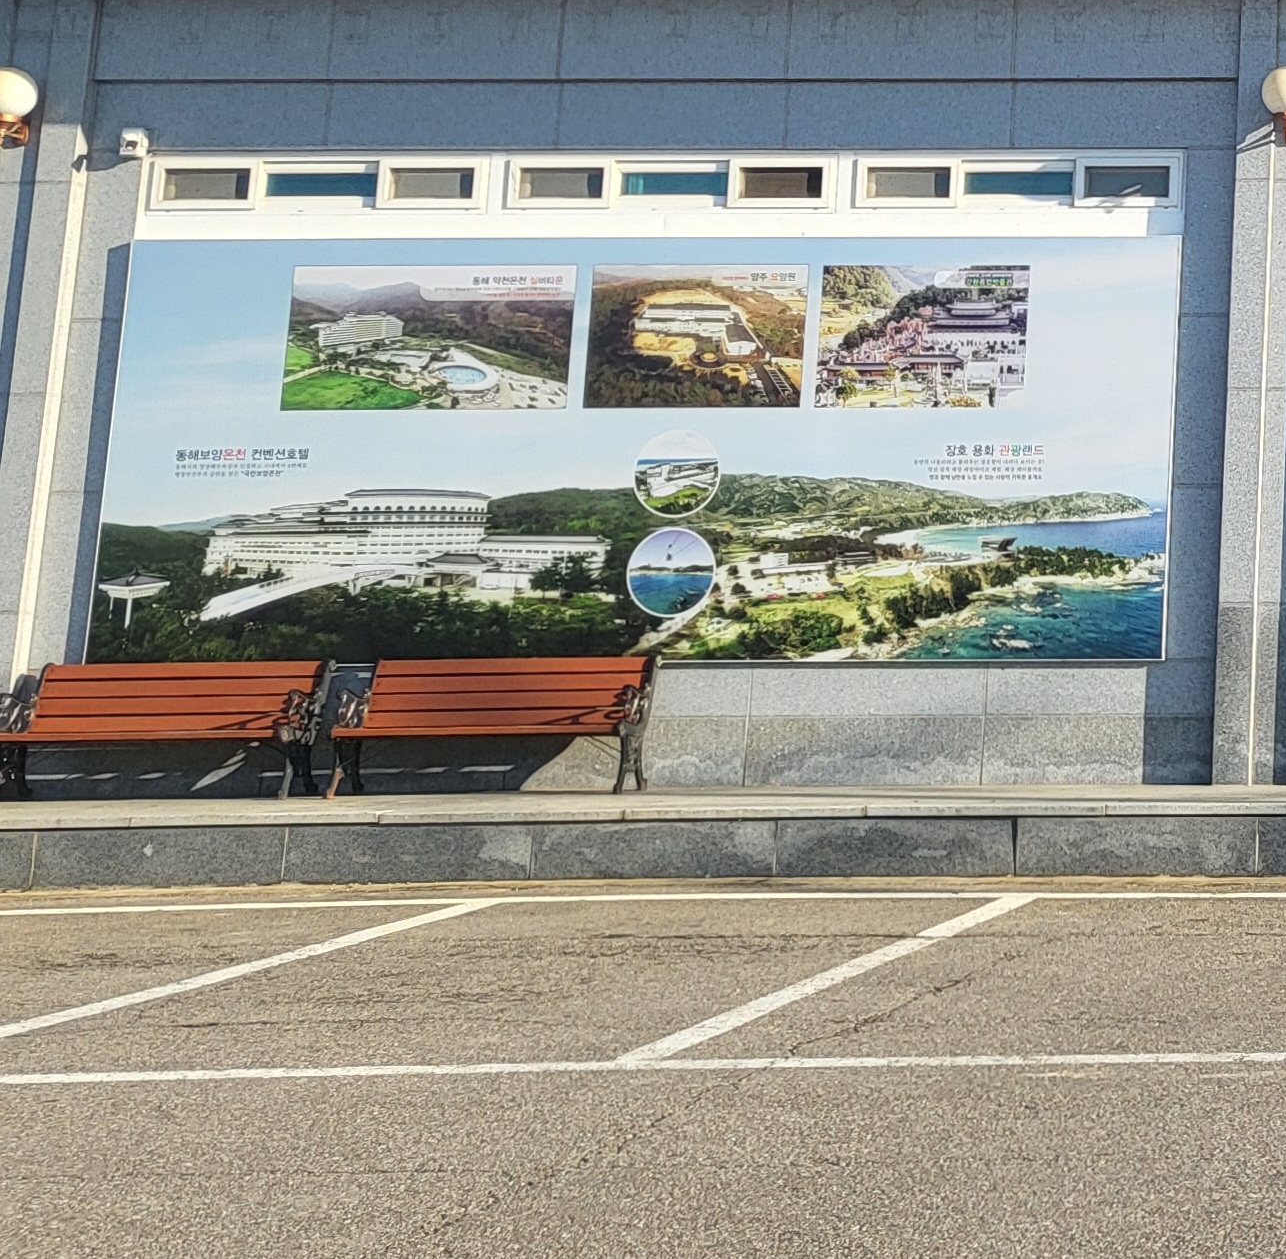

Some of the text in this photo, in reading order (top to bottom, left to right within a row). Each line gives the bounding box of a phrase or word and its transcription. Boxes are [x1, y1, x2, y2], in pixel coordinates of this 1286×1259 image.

[175, 447, 310, 462] 동해보양온천 컨벤션호텔
[945, 444, 968, 457] 장호
[999, 444, 1045, 456] 관광랜드
